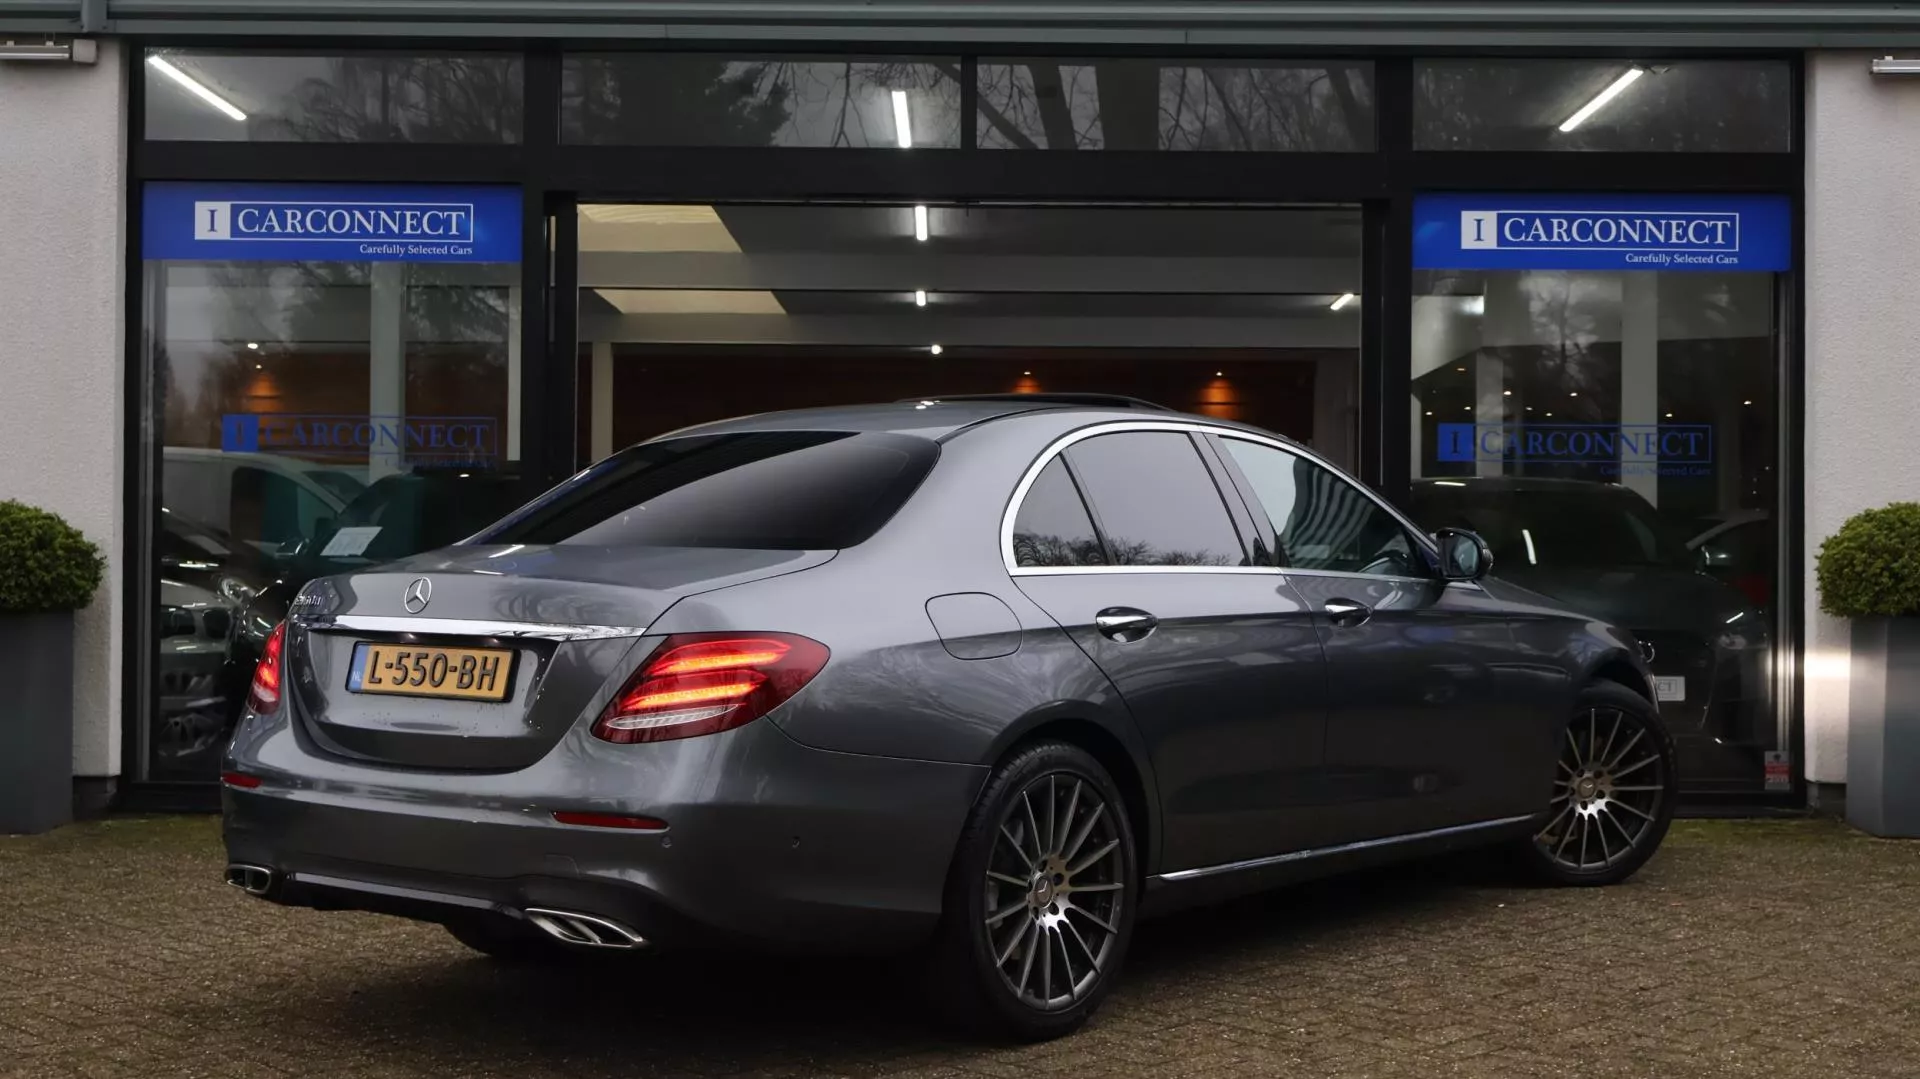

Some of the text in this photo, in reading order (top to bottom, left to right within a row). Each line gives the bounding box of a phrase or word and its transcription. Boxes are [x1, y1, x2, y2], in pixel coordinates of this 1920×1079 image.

[237, 208, 465, 236] CARCONNECT
[1503, 217, 1730, 245] CARCONNECT
[359, 243, 473, 257] Carefully Selected Cars
[1625, 252, 1739, 266] Carefully Selected Cars
[265, 420, 489, 448] CARCONNECT
[1480, 430, 1704, 456] CARCONNECT
[351, 670, 362, 682] NL
[368, 650, 500, 691] L-550-BH
